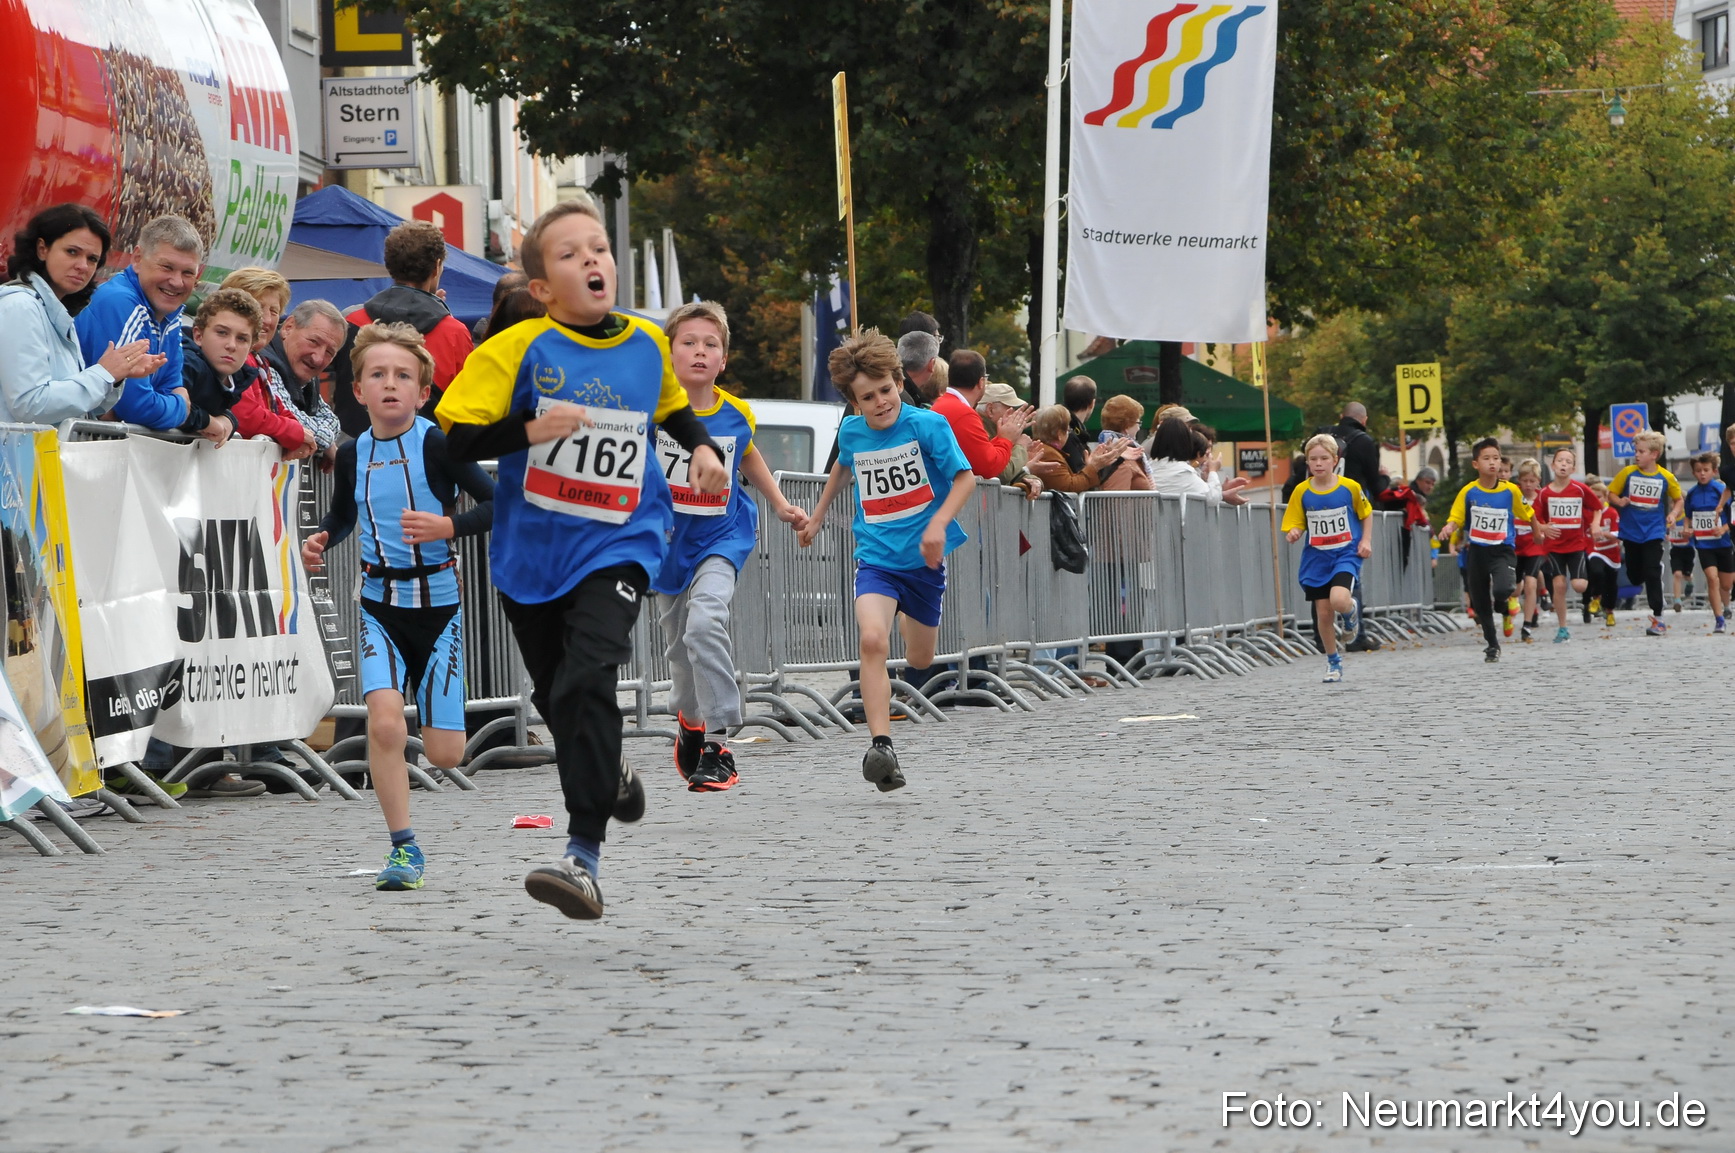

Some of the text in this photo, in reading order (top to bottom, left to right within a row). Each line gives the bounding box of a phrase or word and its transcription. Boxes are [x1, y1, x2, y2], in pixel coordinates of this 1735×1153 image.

[340, 103, 400, 122] Stern
[343, 135, 375, 144] Eingang
[1082, 227, 1258, 249] stadtwerke neumarkt
[1402, 366, 1436, 379] Block
[1409, 384, 1431, 414] D
[1616, 441, 1637, 454] TA
[546, 435, 638, 480] 7162
[874, 452, 909, 465] Neumarkt
[861, 460, 922, 496] 7565
[558, 481, 612, 506] Lorenz
[1633, 484, 1660, 497] 7597
[1551, 505, 1580, 517] 7037
[1311, 517, 1346, 535] 7019
[1474, 515, 1505, 531] 7547
[135, 687, 159, 711] die
